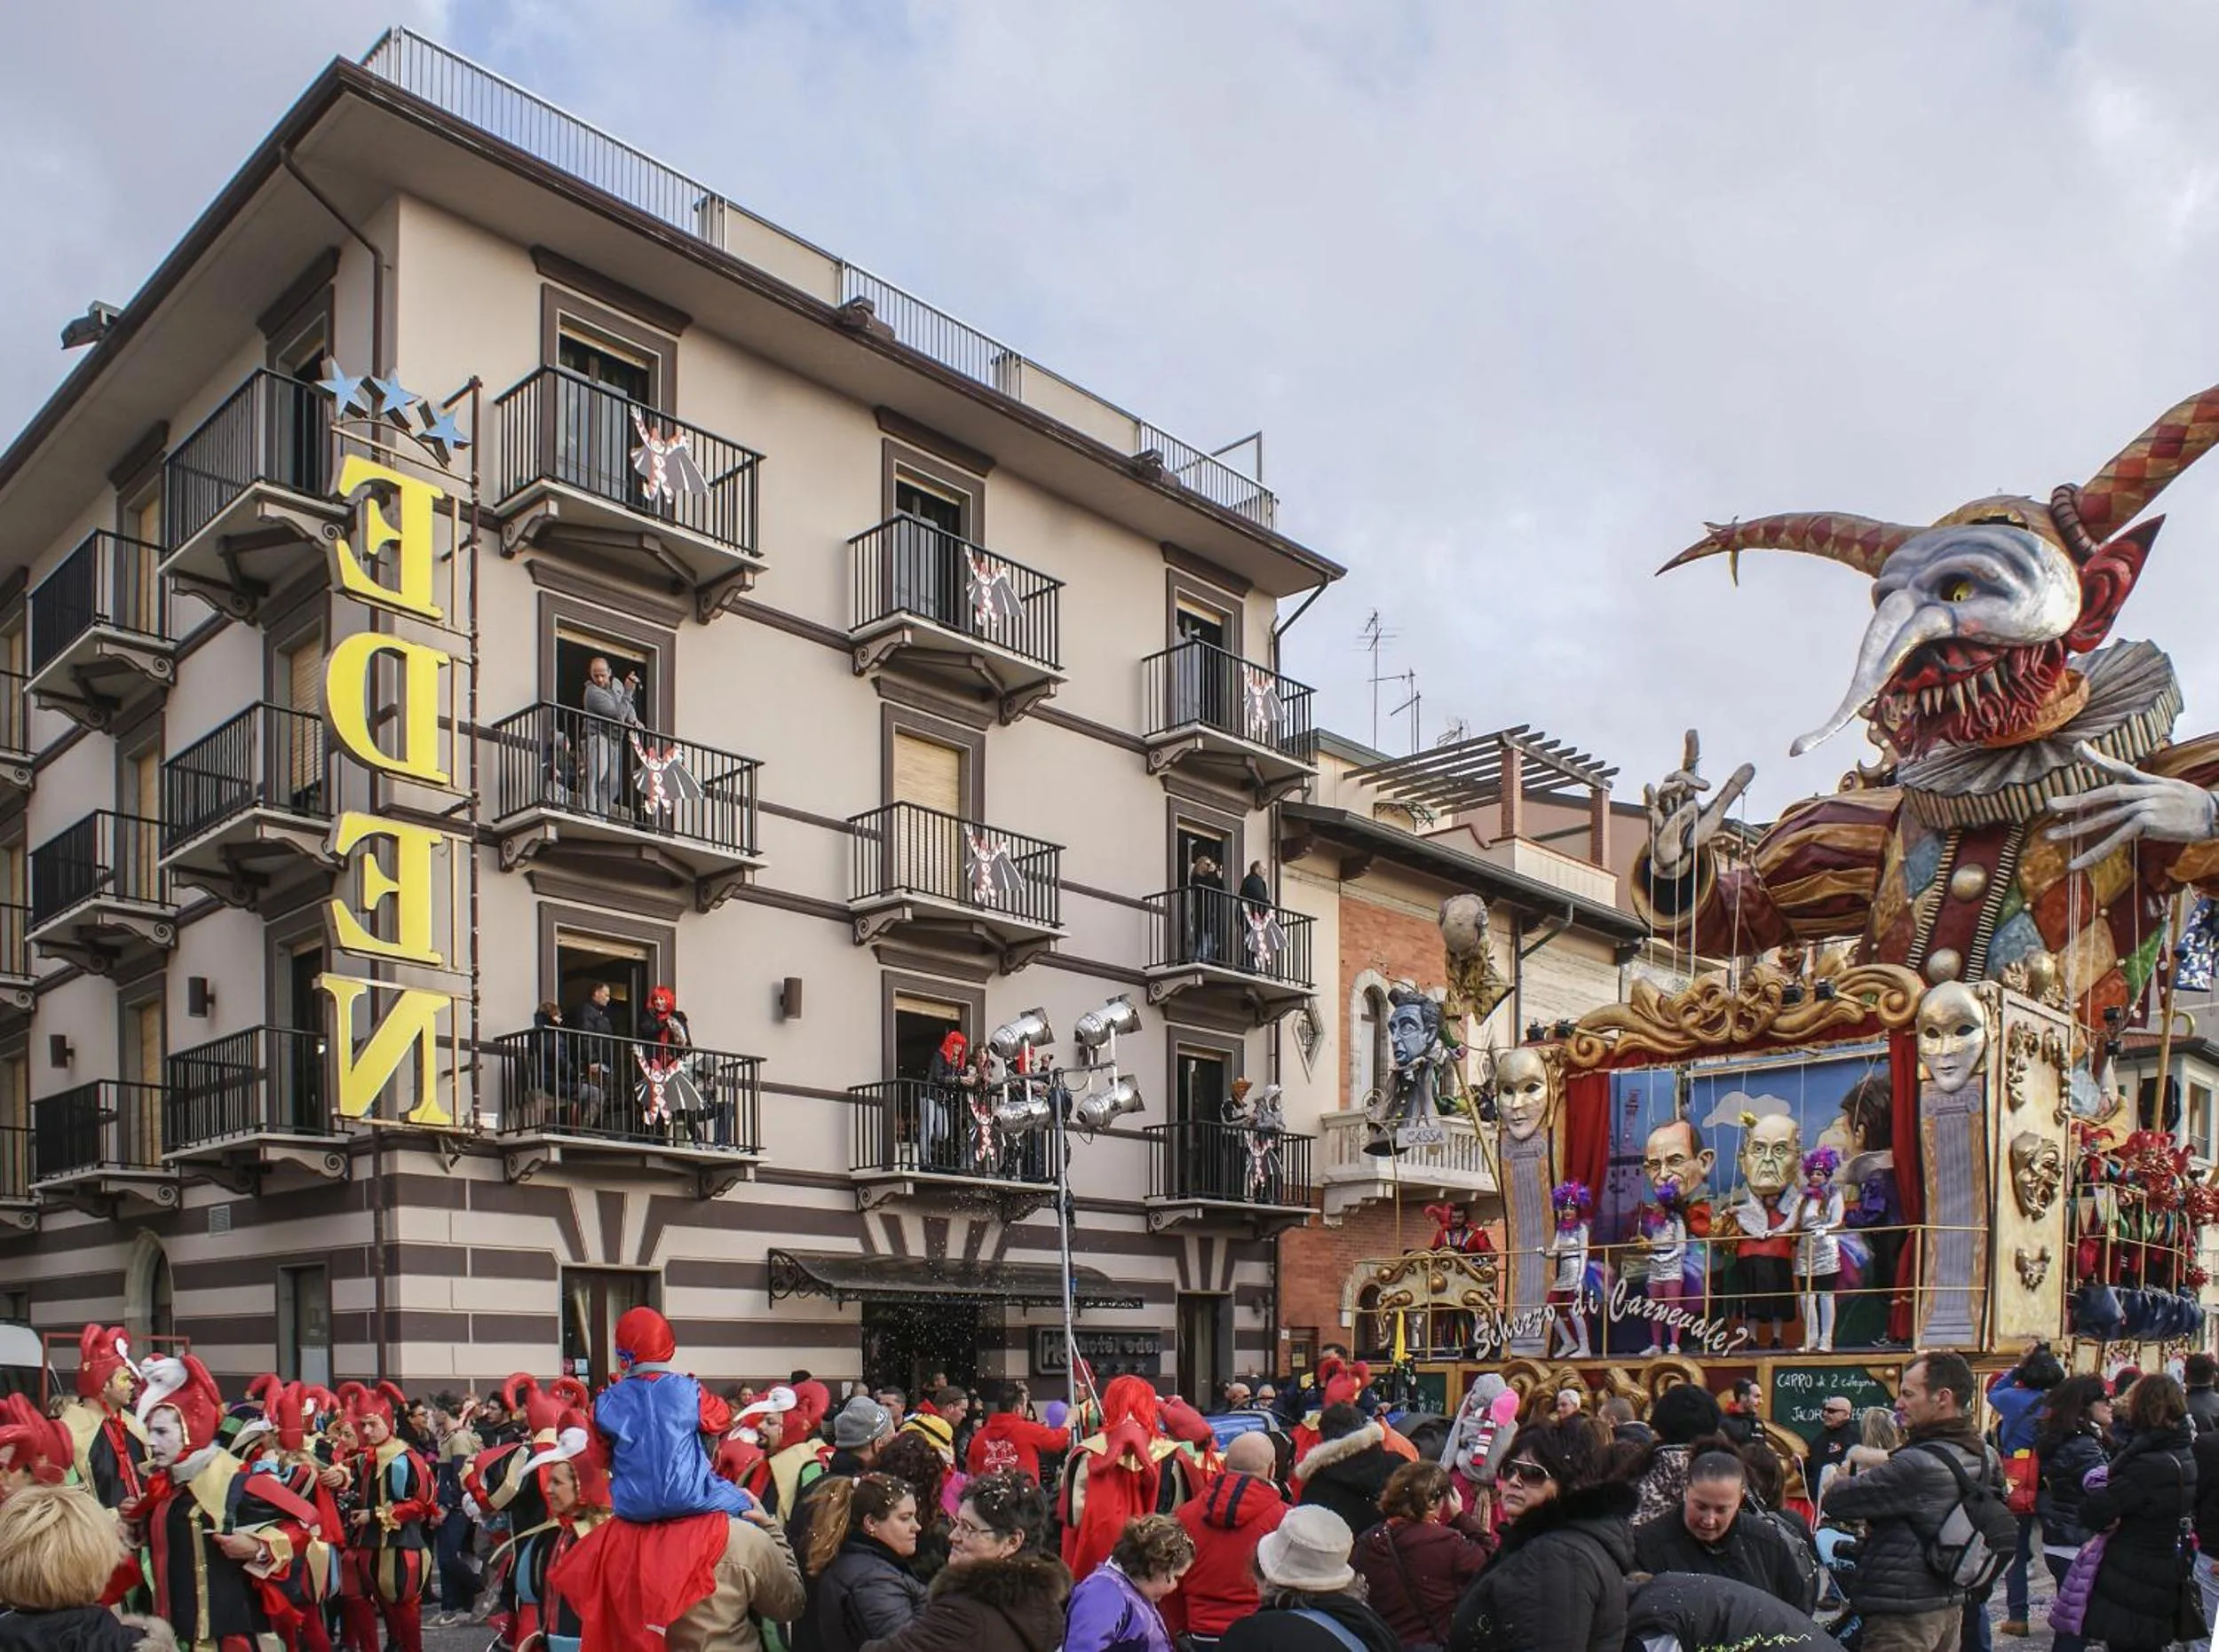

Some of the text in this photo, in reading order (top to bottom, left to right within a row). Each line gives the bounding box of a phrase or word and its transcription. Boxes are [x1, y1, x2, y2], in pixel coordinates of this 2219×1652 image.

[1407, 1129, 1445, 1143] CASSA
[1573, 1282, 1598, 1316] di
[1777, 1373, 1813, 1394] CARRO
[1831, 1373, 1839, 1387] 2
